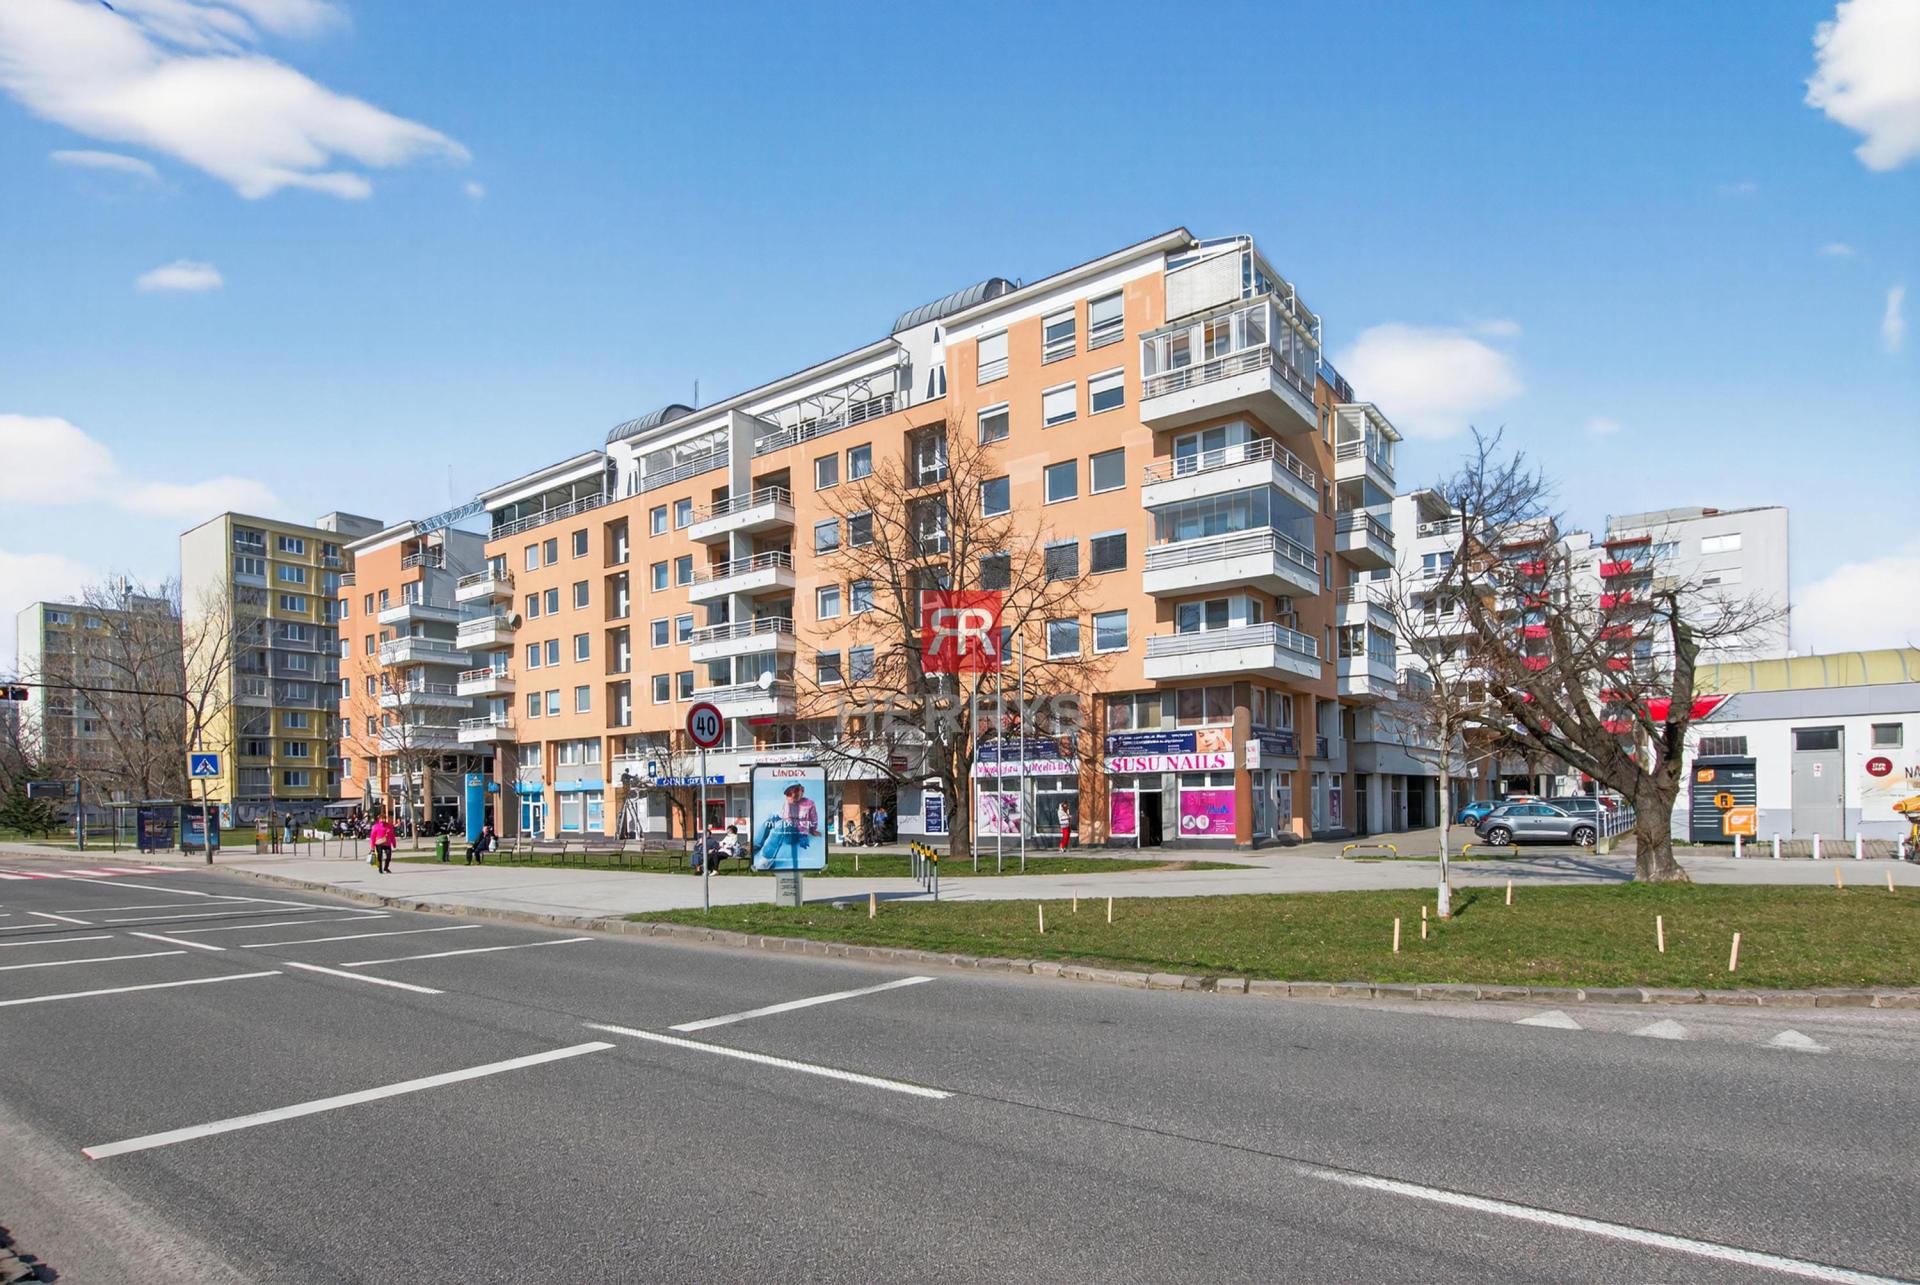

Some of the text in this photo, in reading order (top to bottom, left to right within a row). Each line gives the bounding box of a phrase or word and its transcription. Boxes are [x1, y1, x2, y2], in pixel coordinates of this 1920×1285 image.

[696, 716, 716, 736] 40
[772, 769, 806, 777] LINDEX
[1111, 754, 1226, 773] SUSU NAILS
